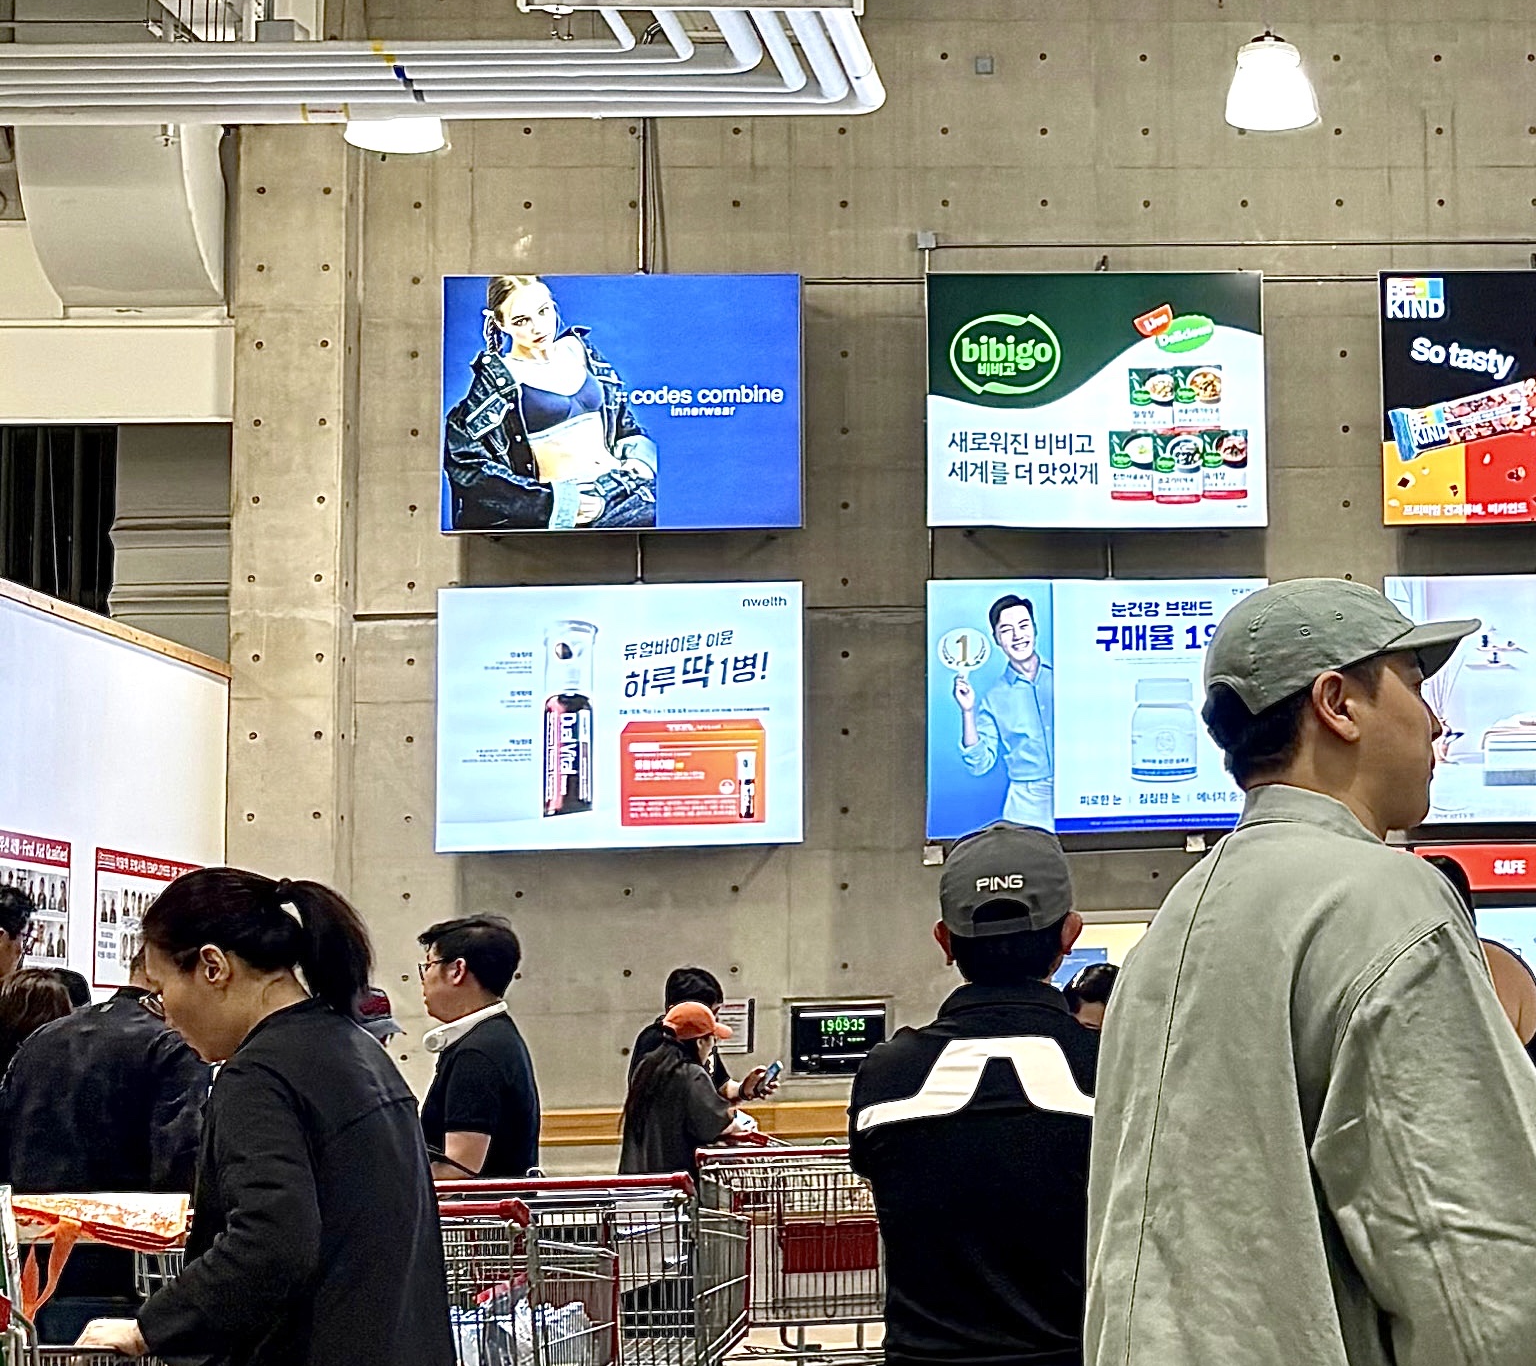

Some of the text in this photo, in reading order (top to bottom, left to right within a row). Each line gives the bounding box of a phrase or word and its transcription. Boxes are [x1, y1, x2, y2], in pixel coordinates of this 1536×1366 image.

[1387, 298, 1445, 319] KIND
[961, 335, 1053, 371] bibigo
[1410, 336, 1514, 380] So tasty
[977, 362, 1017, 376] 비비고
[630, 385, 784, 404] codes combine
[670, 405, 736, 416] innerwear
[948, 431, 1095, 455] 새로워진 비비고
[1412, 424, 1449, 447] KIND
[948, 461, 1099, 485] 세계를 더 맛있게
[742, 596, 787, 607] nwelth
[1111, 601, 1213, 618] 눈건강 브랜드
[1096, 624, 1174, 652] 구매율
[624, 651, 769, 698] 하루 딱 1병!
[1493, 859, 1527, 875] SAFE
[975, 874, 1024, 892] PING
